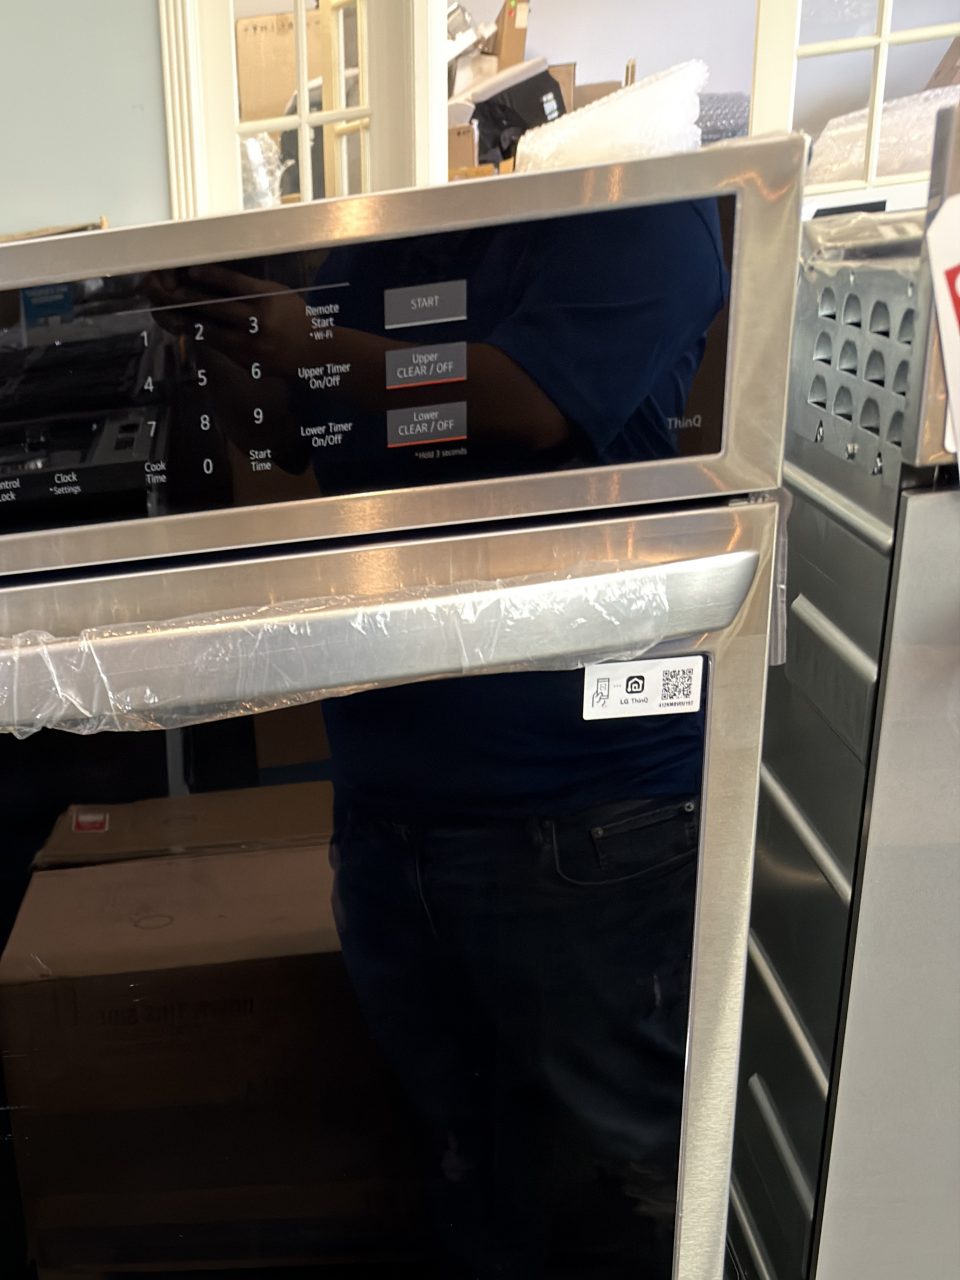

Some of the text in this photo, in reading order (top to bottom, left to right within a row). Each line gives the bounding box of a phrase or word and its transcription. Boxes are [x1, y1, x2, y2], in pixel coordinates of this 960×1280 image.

[306, 303, 340, 316] Remote
[410, 296, 440, 310] START
[248, 316, 259, 334] 3
[311, 316, 334, 328] Start
[141, 331, 148, 347] 1
[194, 324, 205, 341] 2
[412, 352, 438, 366] Upper
[251, 362, 262, 379] 6
[298, 362, 350, 380] Upper Timer
[396, 364, 426, 378] CLEAR
[436, 361, 454, 374] OFF
[144, 376, 154, 392] 4
[198, 370, 207, 386] 5
[309, 376, 340, 389] On/Off
[200, 414, 210, 430] 8
[253, 408, 264, 424] 9
[413, 410, 438, 422] Lower
[667, 414, 702, 430] ThinQ
[147, 420, 157, 437] 7
[300, 421, 352, 437] Lower Timer
[398, 422, 427, 436] CLEAR
[437, 420, 454, 433] OFF
[312, 434, 343, 448] On/Off
[249, 449, 272, 460] Start
[144, 461, 166, 473] Cook
[203, 458, 213, 474] 0
[250, 460, 272, 472] Time
[54, 472, 78, 484] Clock
[146, 472, 166, 484] Time
